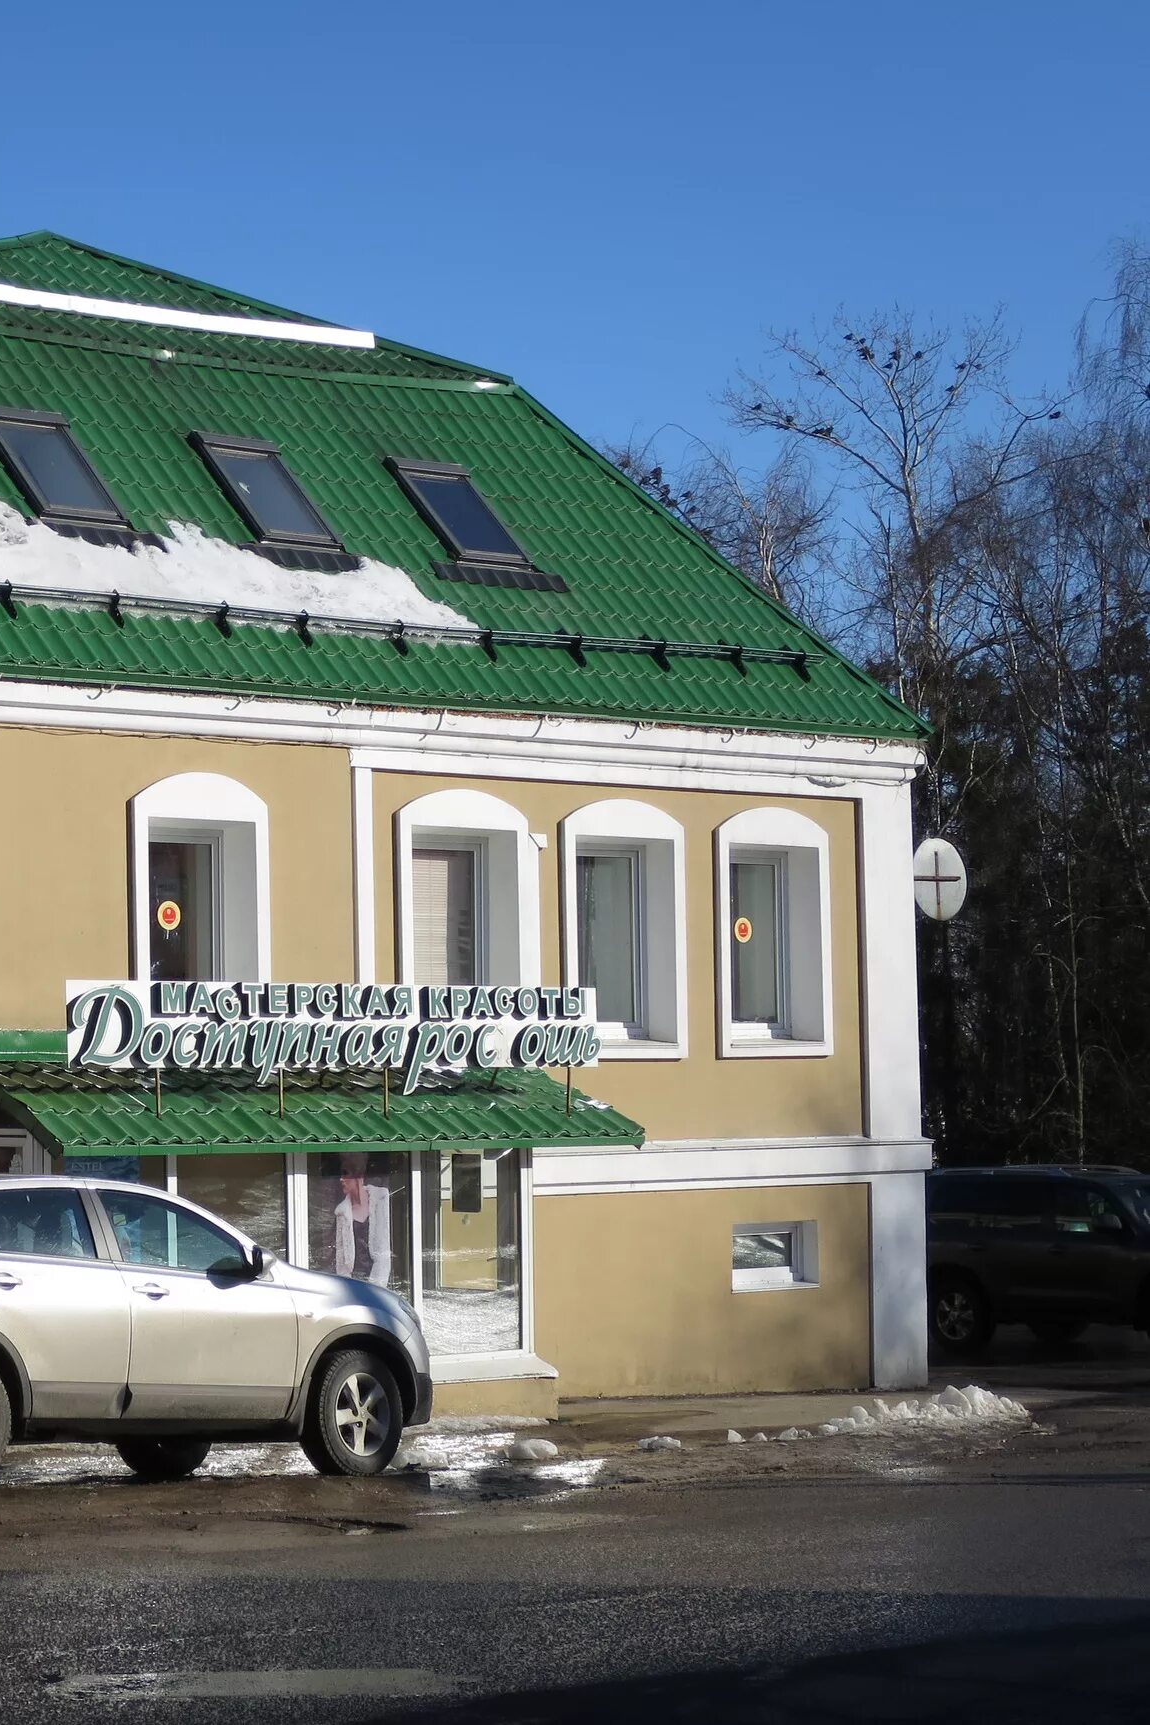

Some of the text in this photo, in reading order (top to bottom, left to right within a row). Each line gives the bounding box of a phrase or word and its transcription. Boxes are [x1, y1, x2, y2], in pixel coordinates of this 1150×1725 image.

[159, 981, 588, 1021] МАСТЕРСКАЯ КРАСОТЫ
[71, 984, 603, 1096] Доступная росошь
